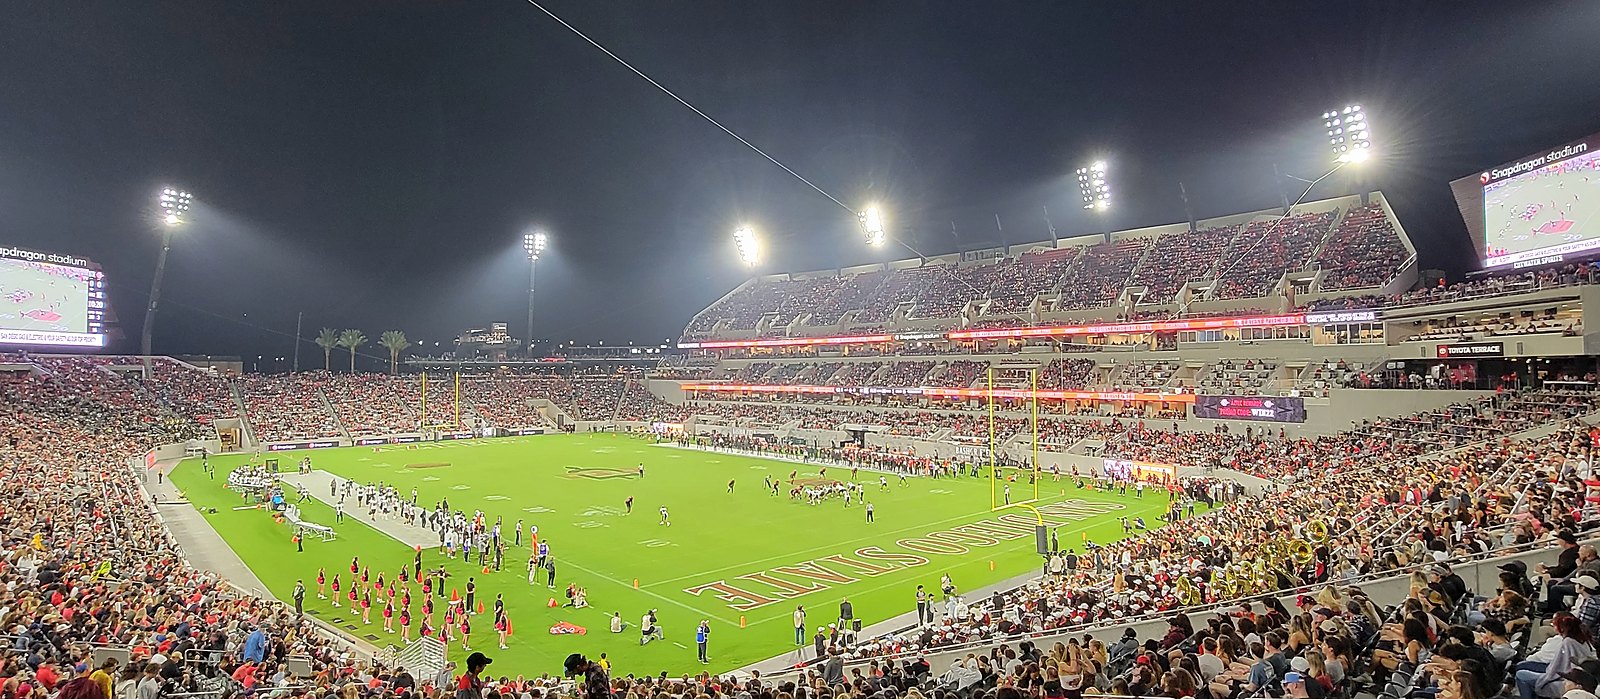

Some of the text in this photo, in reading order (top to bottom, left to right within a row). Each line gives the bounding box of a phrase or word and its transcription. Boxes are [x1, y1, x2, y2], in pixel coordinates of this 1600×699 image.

[1491, 142, 1587, 180] Snapdragon stadium
[0, 247, 87, 267] pdragon stadium
[1447, 345, 1500, 354] TOYOTA TERRACE
[682, 546, 930, 612] STATE
